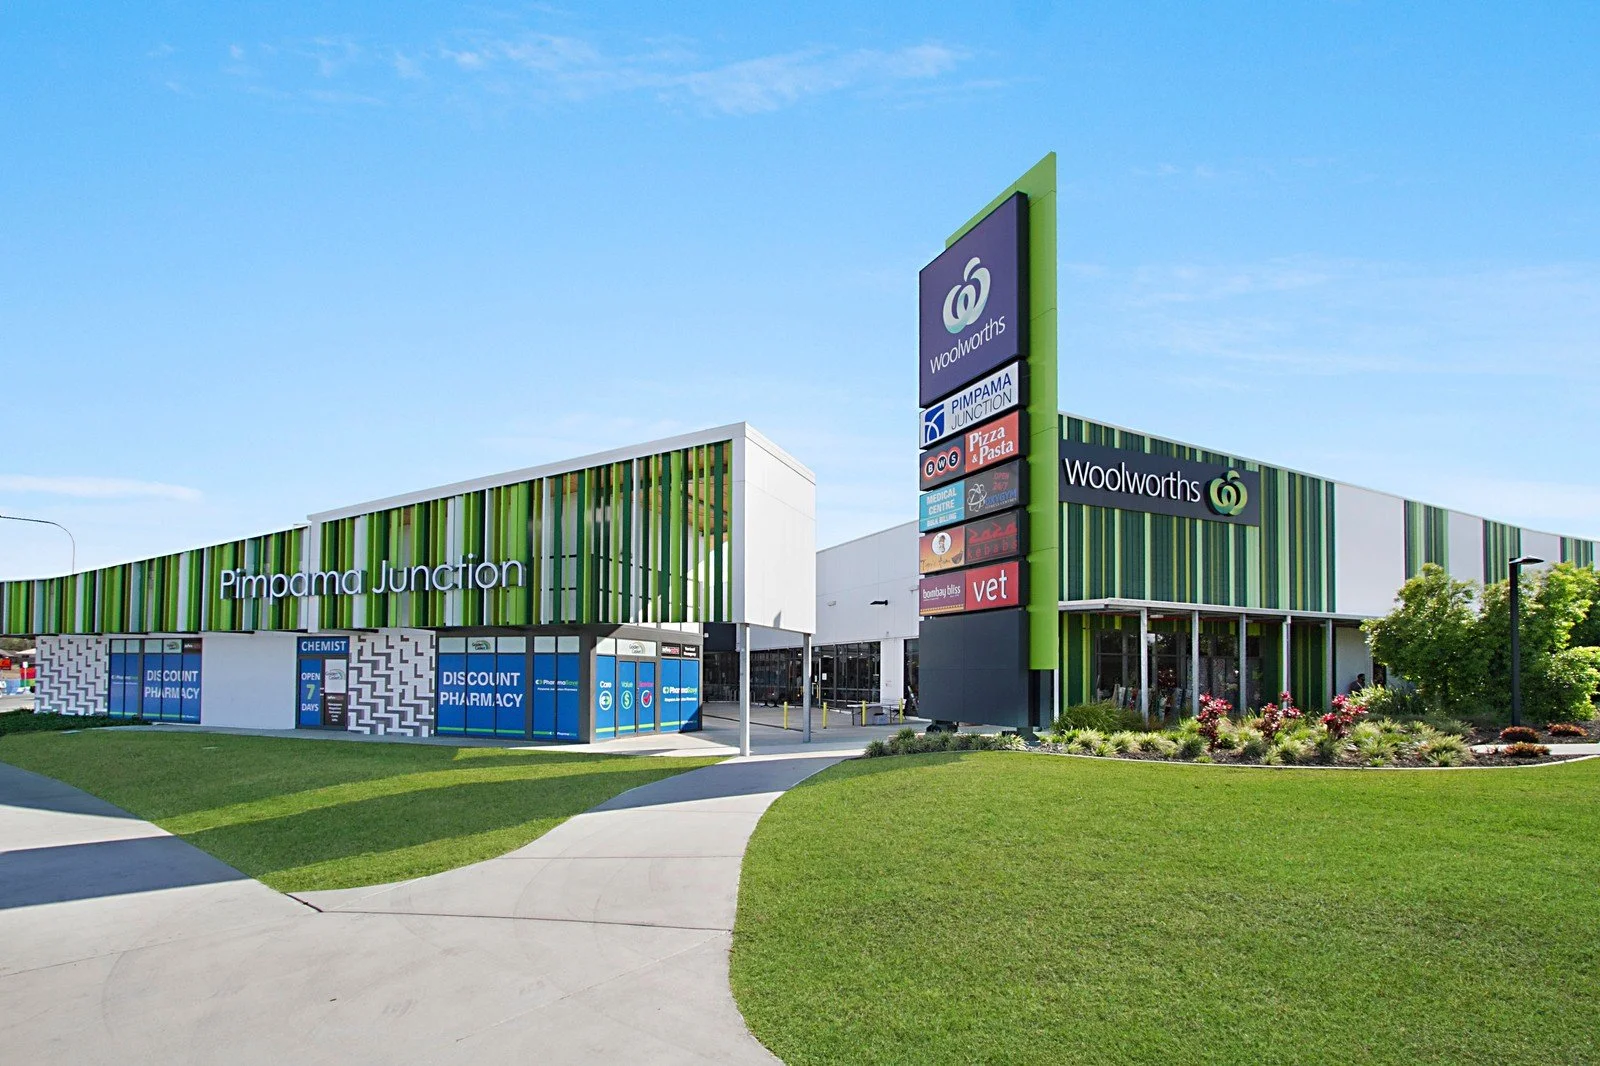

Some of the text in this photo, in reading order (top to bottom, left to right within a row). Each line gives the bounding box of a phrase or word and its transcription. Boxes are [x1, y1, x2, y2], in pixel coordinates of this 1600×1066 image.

[929, 315, 1006, 374] Woolworths
[951, 373, 1012, 414] PIMPAMA
[951, 388, 1012, 430] JUNCTION
[969, 426, 1006, 452] Pizza
[979, 440, 1014, 465] Pasta
[925, 451, 959, 476] BWS
[1064, 458, 1201, 503] Woolworths
[926, 488, 957, 505] MEDICAL
[928, 500, 955, 515] CENTRE
[220, 553, 523, 605] Pimpama Junction
[973, 569, 1007, 602] vet
[922, 584, 961, 599] bombay bliss
[301, 641, 346, 651] CHEMIST
[147, 670, 198, 682] DISCOUNT
[301, 672, 320, 680] OPEN
[443, 671, 520, 686] DISCOUNT
[144, 686, 200, 699] PHARMACY
[306, 683, 316, 700] 7
[440, 692, 523, 708] PHARMACY
[301, 703, 319, 712] DAYS
